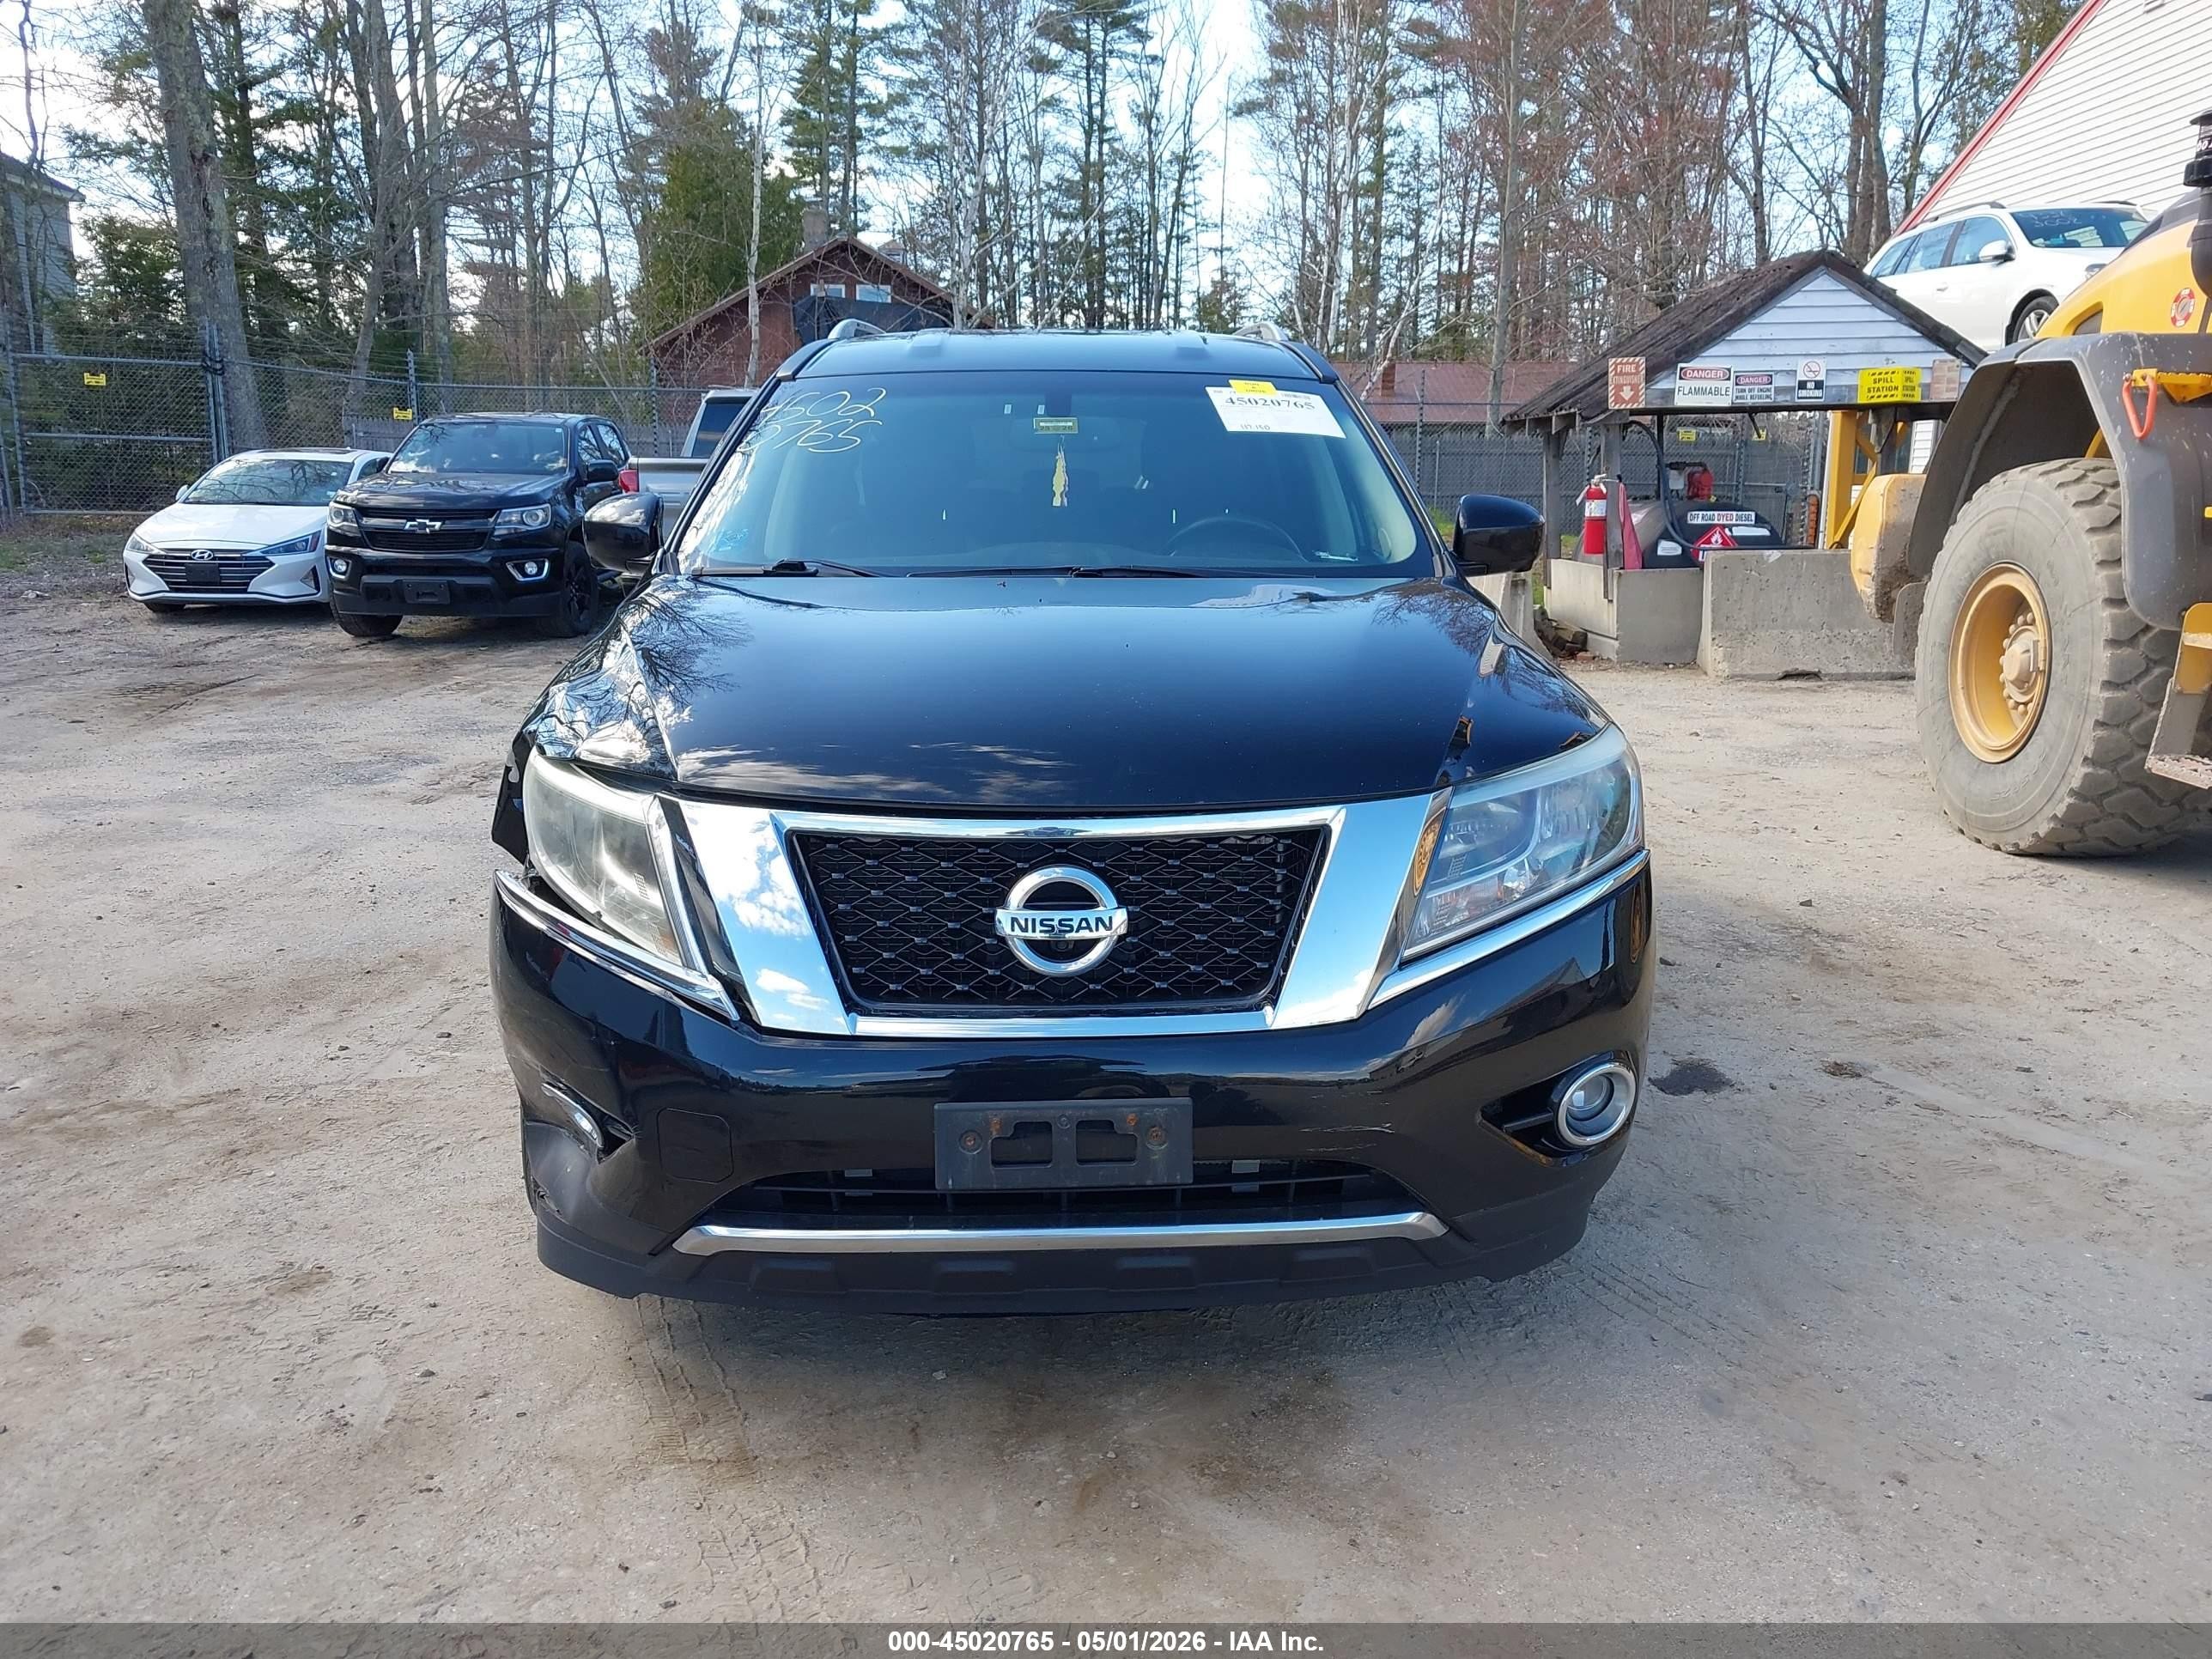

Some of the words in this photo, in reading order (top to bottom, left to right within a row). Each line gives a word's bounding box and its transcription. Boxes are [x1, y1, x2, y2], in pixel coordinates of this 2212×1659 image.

[1617, 364, 1637, 373] FIRE
[1686, 369, 1723, 378] DANGER
[1677, 386, 1730, 396] FLAMMABLE
[1798, 389, 1822, 398] SMOKING
[1867, 385, 1899, 393] STATION
[1224, 397, 1316, 410] 45020765
[1689, 514, 1700, 522] OFF
[1701, 514, 1716, 522] ROAD
[1717, 513, 1734, 522] DYED
[1735, 513, 1753, 522] DIESEL
[1010, 915, 1113, 933] NISSAN
